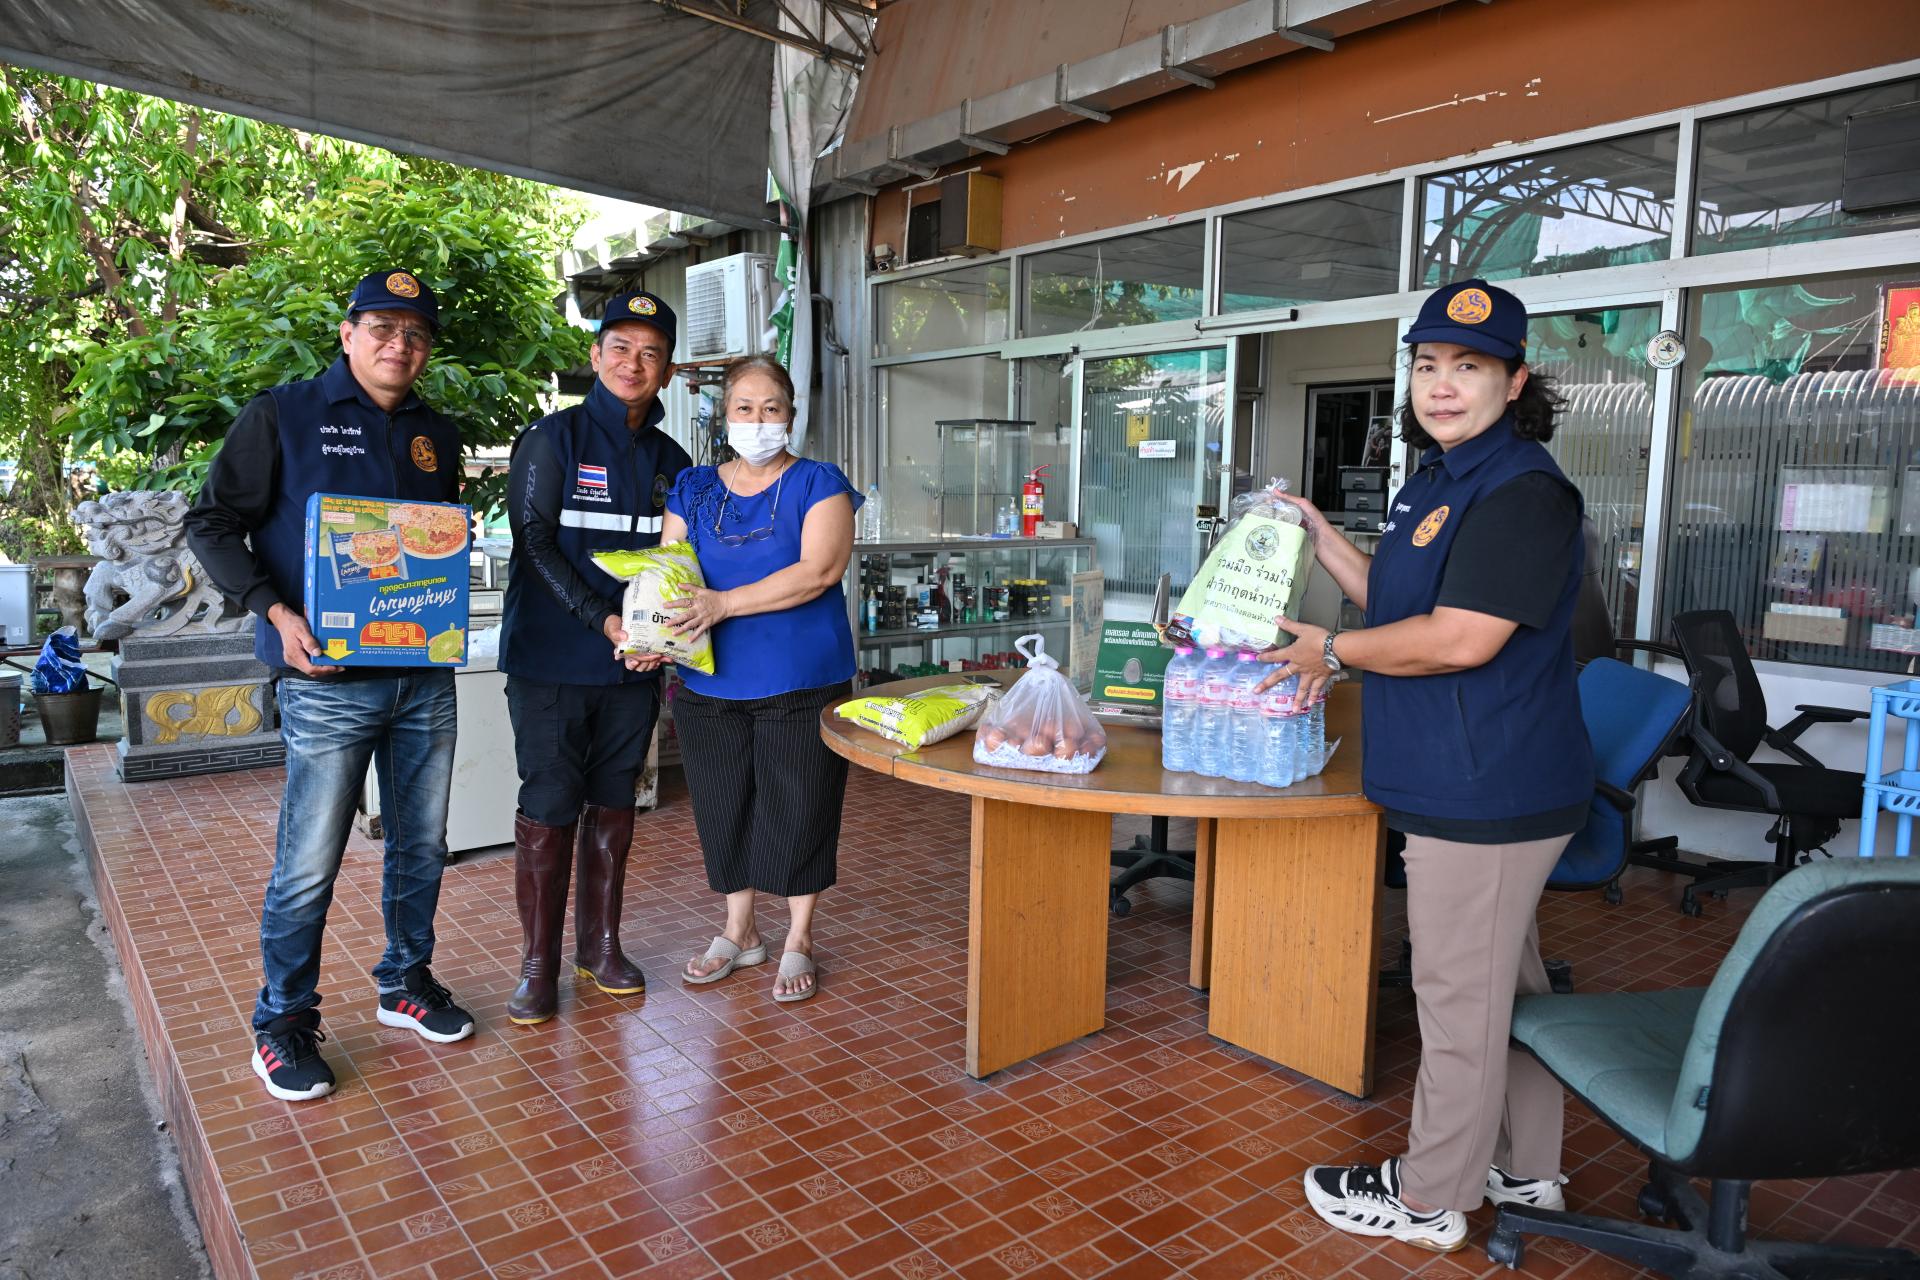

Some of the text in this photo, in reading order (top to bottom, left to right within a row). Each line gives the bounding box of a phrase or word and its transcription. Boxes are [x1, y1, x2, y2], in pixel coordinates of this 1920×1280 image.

[523, 461, 537, 508] PRIX
[1256, 564, 1294, 588] ร่วมใจ
[369, 586, 458, 618] รสหมูสับต้มยำ
[1203, 599, 1276, 626] เทศบาลเมืองดอนหัวฬ่
[368, 622, 425, 646] ไวไว
